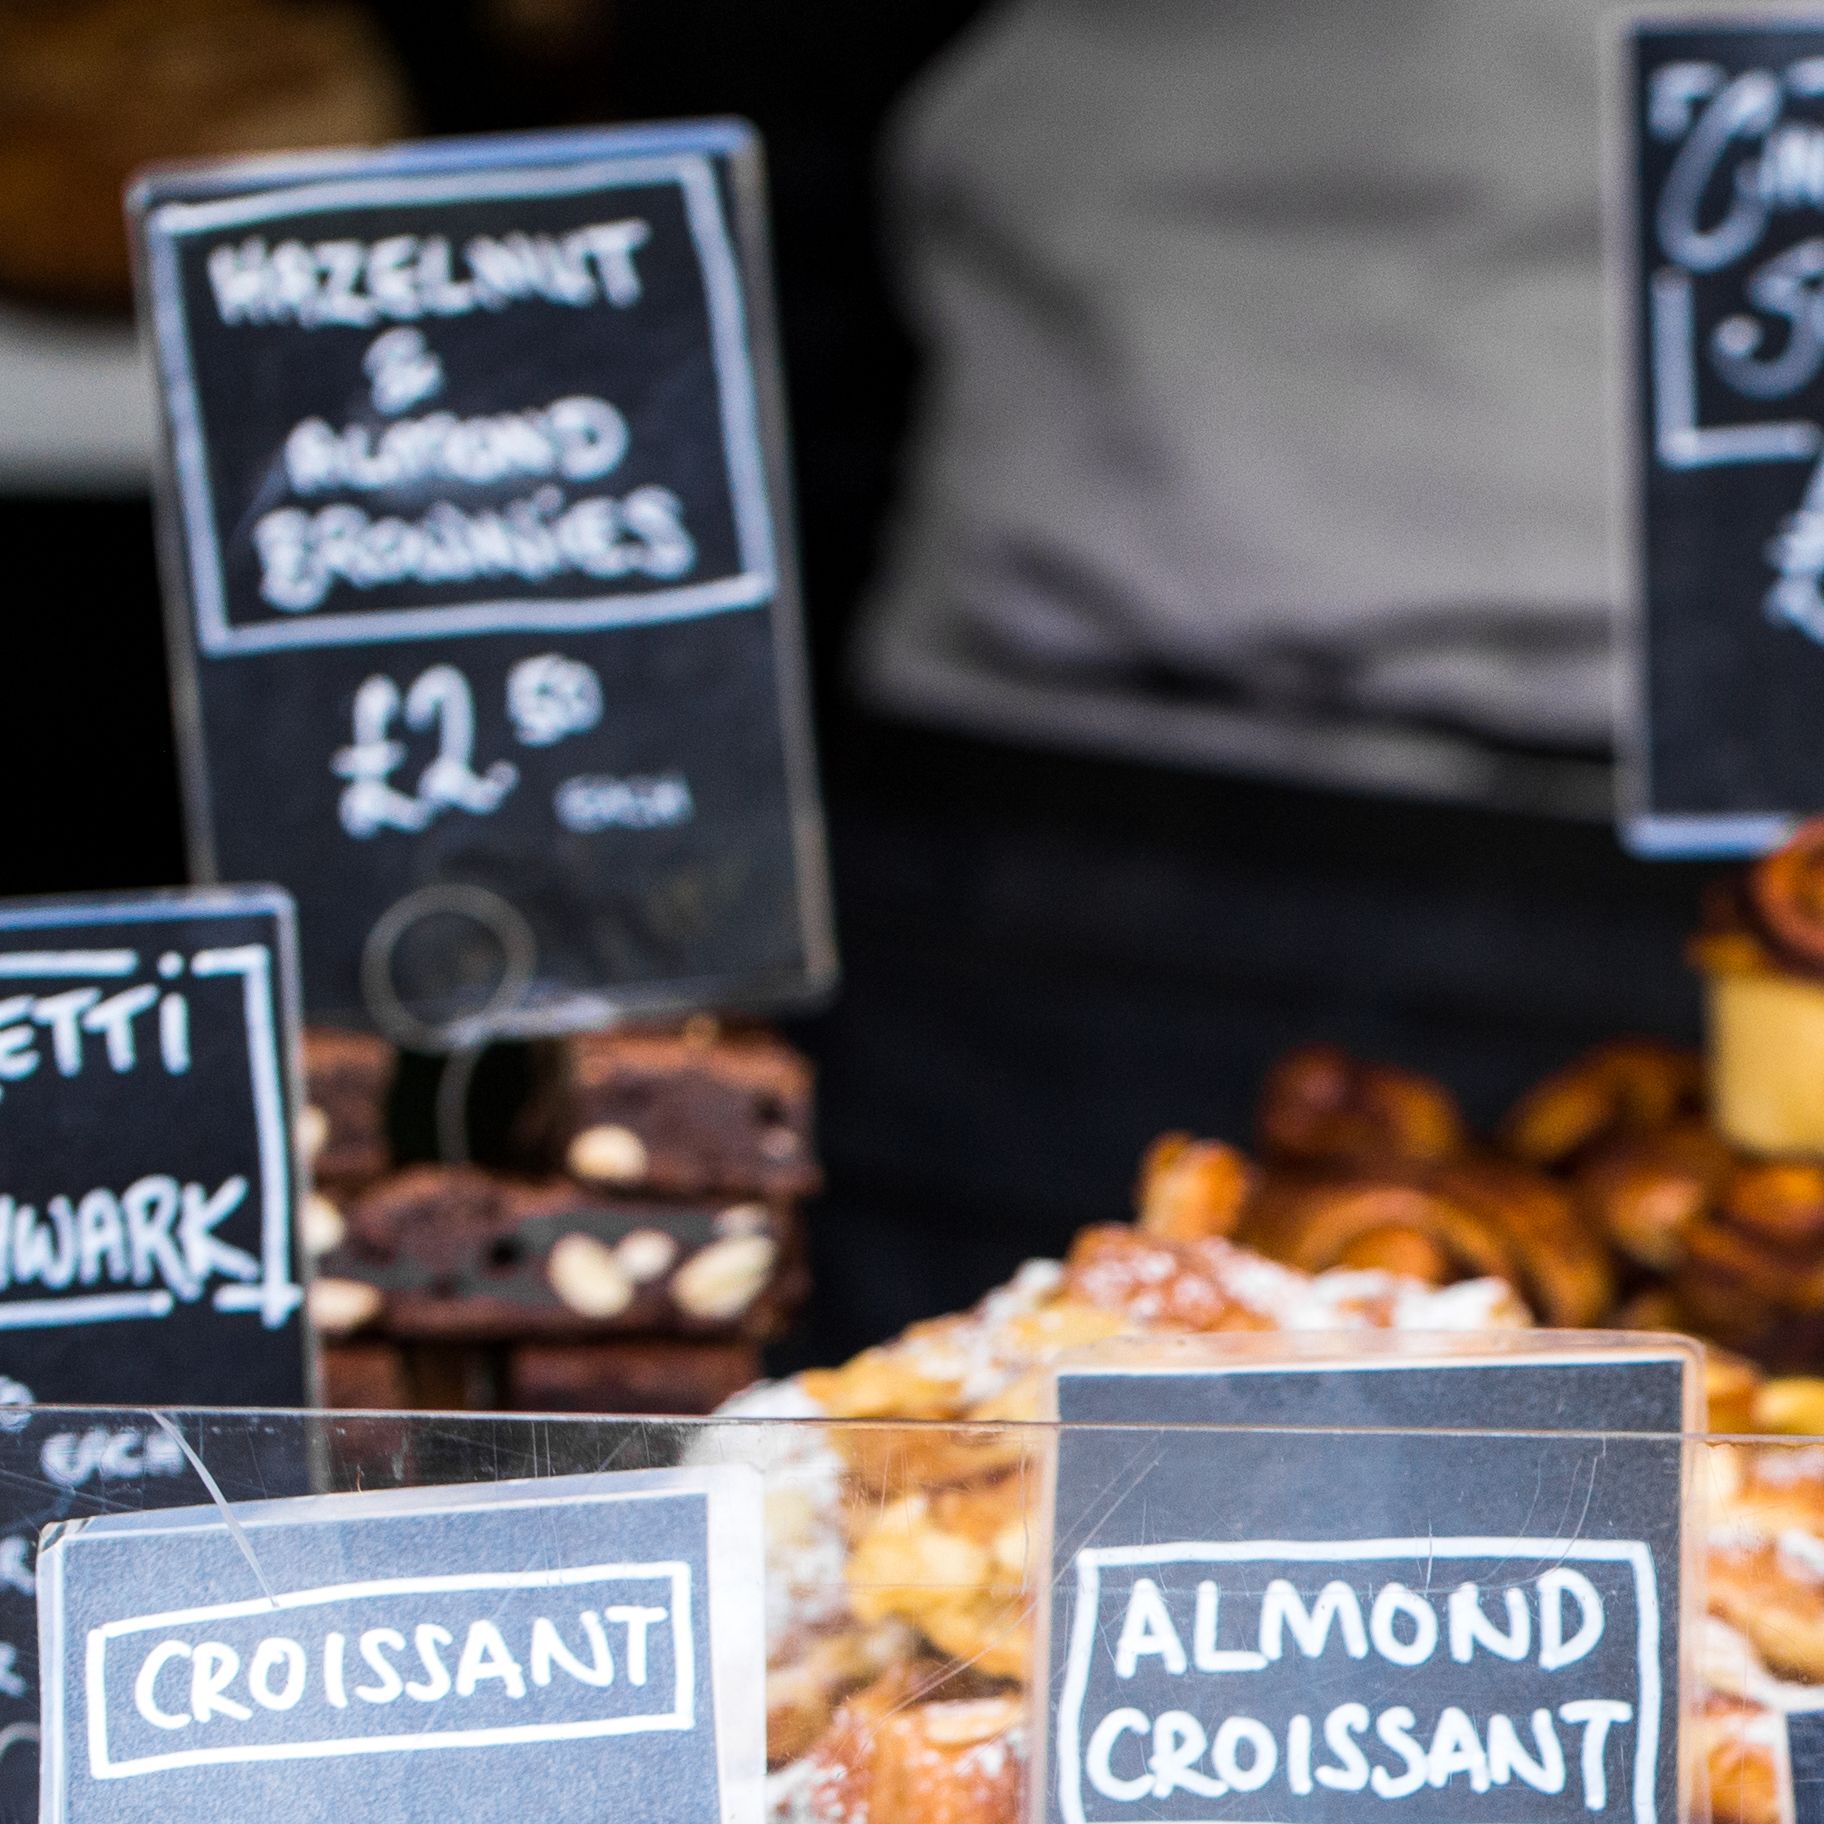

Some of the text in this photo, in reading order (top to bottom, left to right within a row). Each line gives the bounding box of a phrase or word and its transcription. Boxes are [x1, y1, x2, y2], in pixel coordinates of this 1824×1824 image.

[209, 219, 650, 327] HAZELNUT
[134, 1604, 668, 1730] CROISSANT
[1114, 1566, 1604, 1680] ALMOND
[1086, 1699, 1632, 1812] CROISSANT
